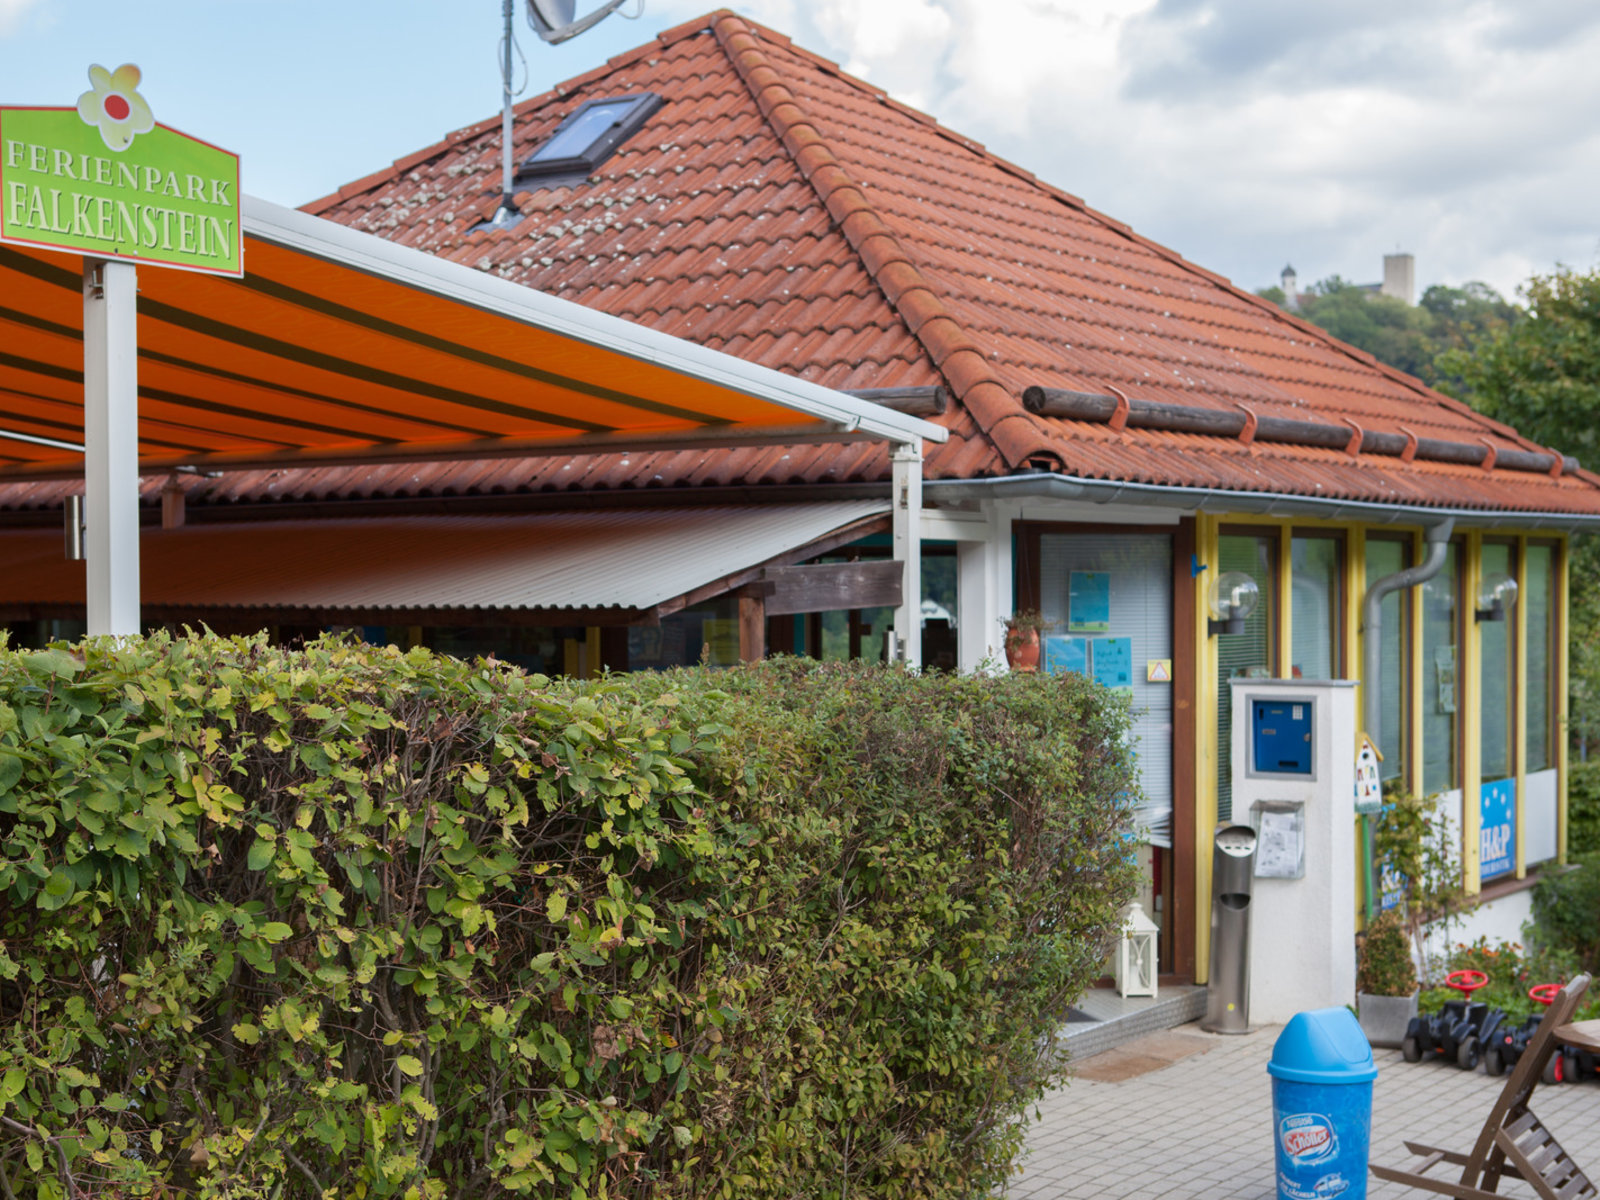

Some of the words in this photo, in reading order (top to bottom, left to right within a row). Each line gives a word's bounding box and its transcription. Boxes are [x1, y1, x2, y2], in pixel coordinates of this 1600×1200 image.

[6, 139, 232, 208] FERIENPARK
[7, 180, 233, 259] FALKENSTEIN
[1480, 823, 1511, 863] H&P
[1285, 1131, 1328, 1155] Schöller
